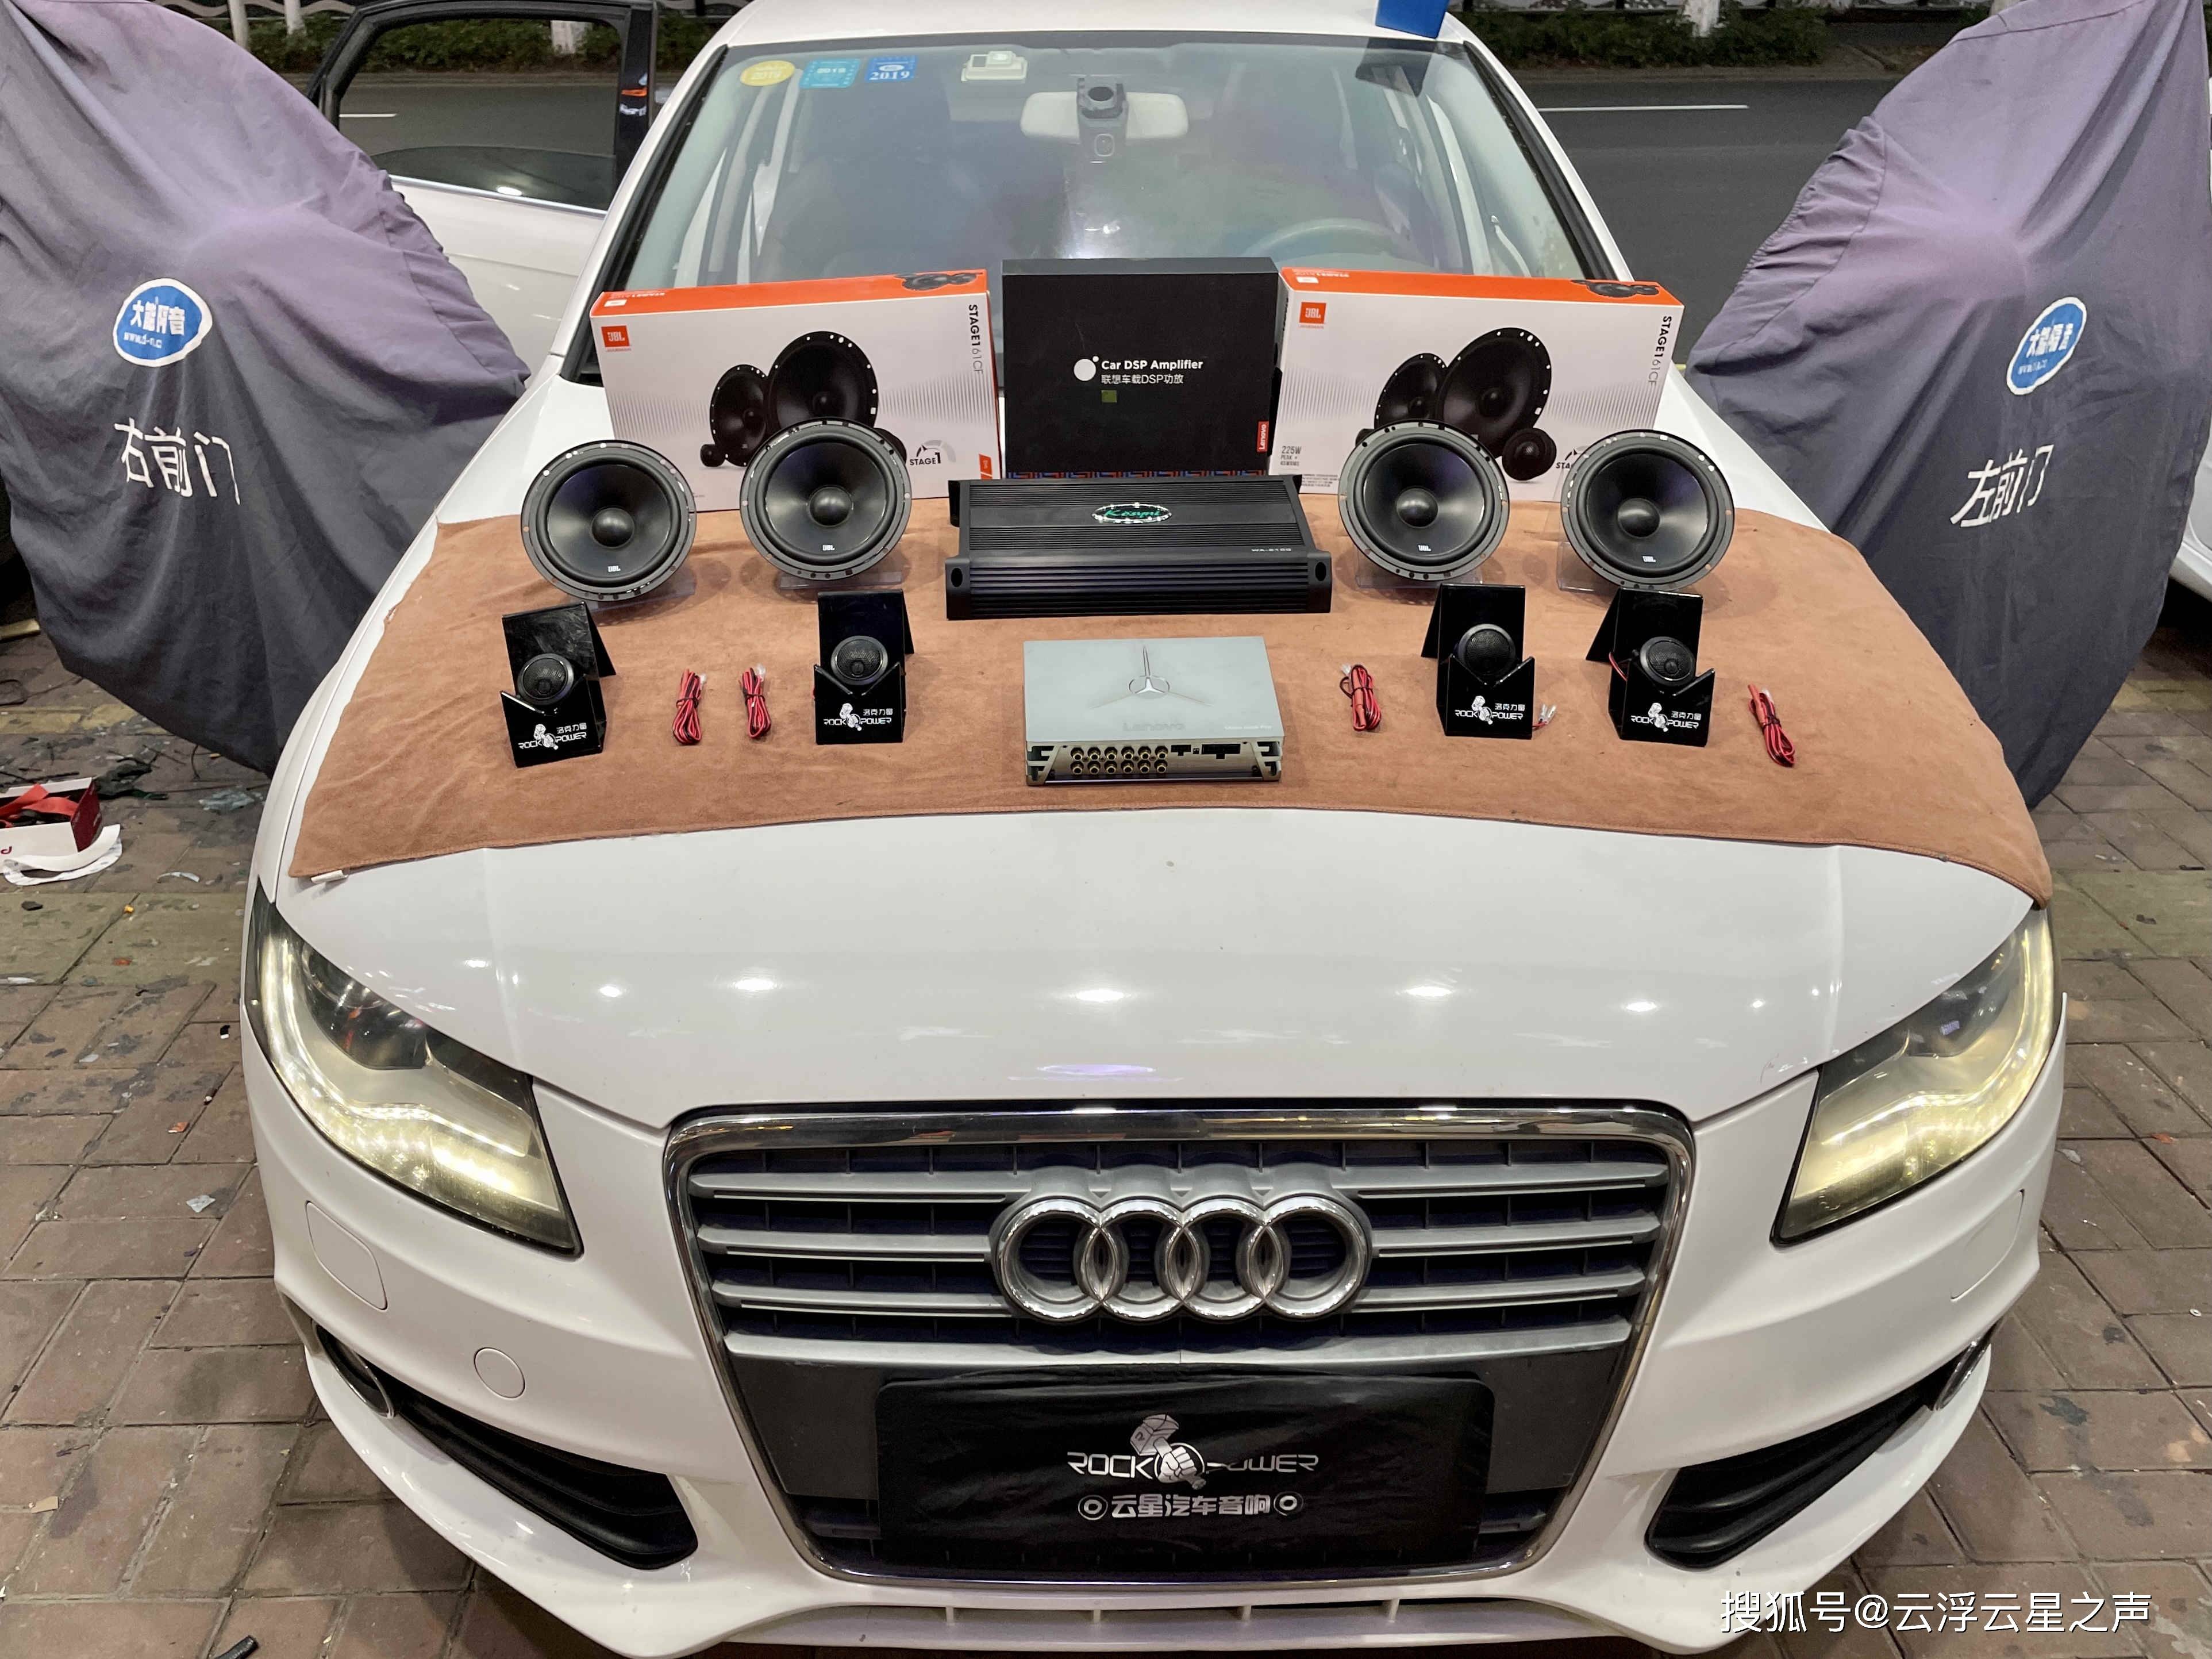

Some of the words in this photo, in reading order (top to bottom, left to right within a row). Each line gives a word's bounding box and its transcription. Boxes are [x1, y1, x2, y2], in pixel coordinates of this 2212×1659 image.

[868, 71, 910, 80] 2019
[1305, 308, 1321, 319] JBL
[607, 331, 625, 342] JBL
[1101, 360, 1121, 370] Car
[1124, 360, 1148, 370] DSP
[1150, 359, 1204, 371] Amplifier
[1101, 374, 1184, 385] 联想车载DSP功放
[1259, 424, 1267, 450] Lenovo
[1282, 446, 1302, 454] 225W
[114, 417, 241, 505] 右前门
[910, 452, 941, 466] STAGE1
[1950, 444, 2055, 528] 左前门
[823, 717, 847, 725] ROCK
[860, 717, 892, 725] POWER
[1455, 709, 1478, 718] ROCK
[1491, 712, 1524, 720] POWER
[1630, 715, 1654, 724] ROCK
[1667, 719, 1699, 729] POWER
[518, 740, 543, 750] ROCK
[556, 732, 587, 743] POWER
[1067, 1451, 1154, 1480] ROCK
[1111, 1494, 1271, 1518] 云星汽车音响
